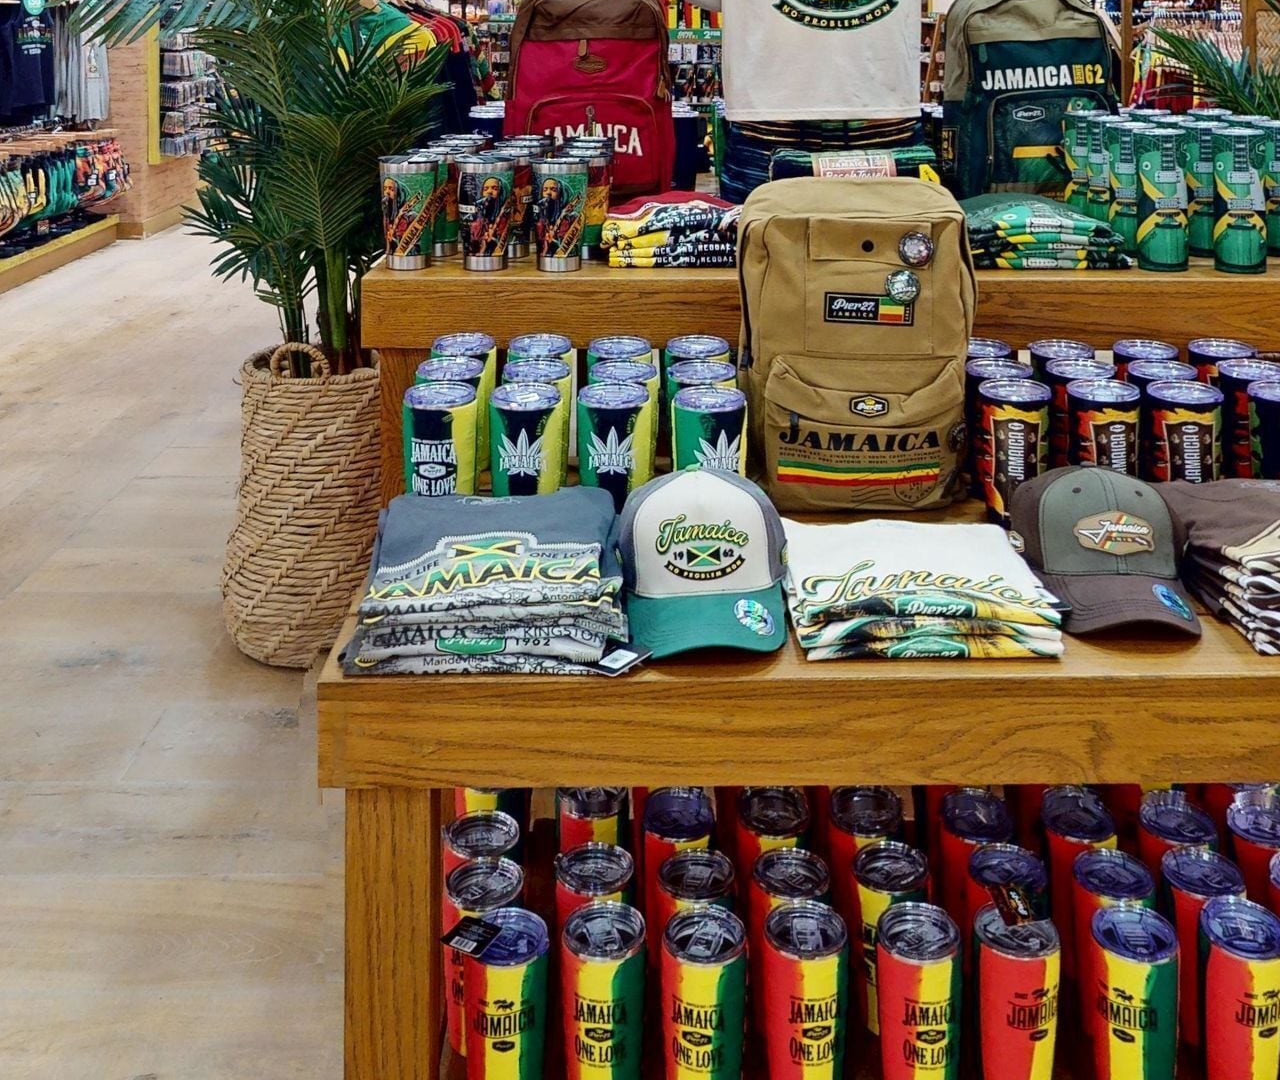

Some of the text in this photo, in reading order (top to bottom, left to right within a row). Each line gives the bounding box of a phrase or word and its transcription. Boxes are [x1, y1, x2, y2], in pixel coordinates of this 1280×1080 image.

[782, 3, 891, 27] NO PROBLEM MON
[981, 64, 1071, 90] JAMAICA
[1085, 64, 1105, 84] 62
[410, 442, 457, 463] JAMAICA
[779, 428, 941, 452] JAMAICA
[1008, 435, 1025, 481] JAMAICA
[1184, 436, 1201, 483] JAMAICA
[412, 475, 457, 496] ONE LOVE
[655, 514, 750, 555] Jamaica
[1079, 520, 1150, 544] Jamaica
[528, 551, 559, 559] ONE
[673, 549, 734, 560] 19 62
[382, 559, 441, 584] ONE LIFE
[668, 560, 742, 579] NO PROBLEM MON
[906, 600, 965, 617] Pier27
[523, 626, 606, 644] KINGSTON
[474, 1005, 535, 1038] JAMAICA
[574, 998, 626, 1025] JAMAICA
[671, 1000, 724, 1031] JAMAICA
[1098, 997, 1158, 1030] JAMAICA
[575, 1035, 595, 1062] ONE
[673, 1040, 693, 1066] ONE
[790, 1036, 838, 1062] ONE LOV
[903, 1040, 953, 1065] ONE LOV
